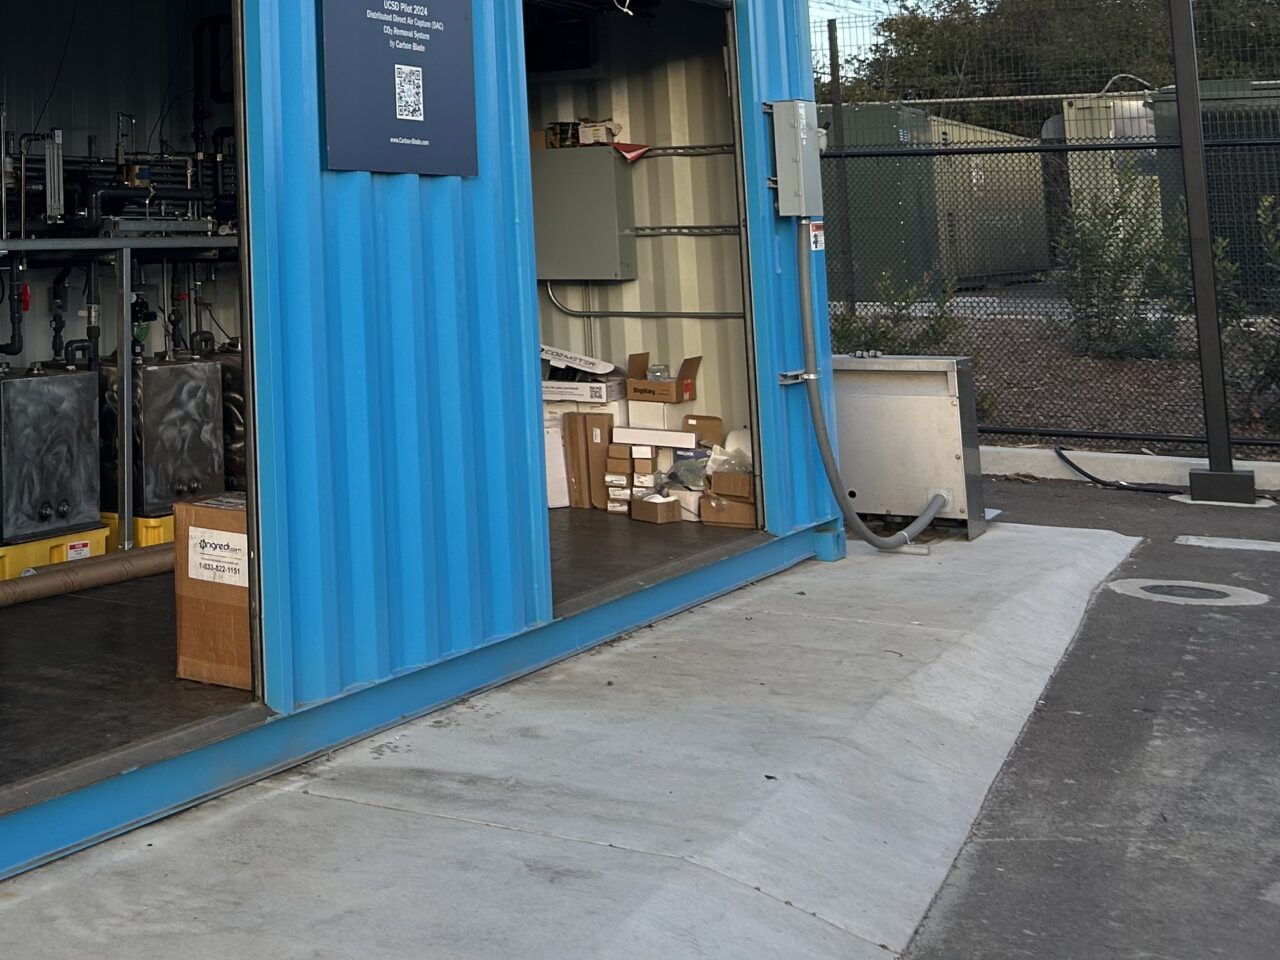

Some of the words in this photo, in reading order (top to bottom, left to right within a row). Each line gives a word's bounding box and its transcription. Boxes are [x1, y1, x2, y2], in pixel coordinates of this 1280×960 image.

[383, 0, 399, 12] UCSD
[400, 2, 412, 14] Pilot
[413, 5, 428, 16] 2024
[366, 9, 393, 23] Distributed
[393, 14, 407, 25] Direct
[199, 562, 240, 575] 1-833-822-1151
